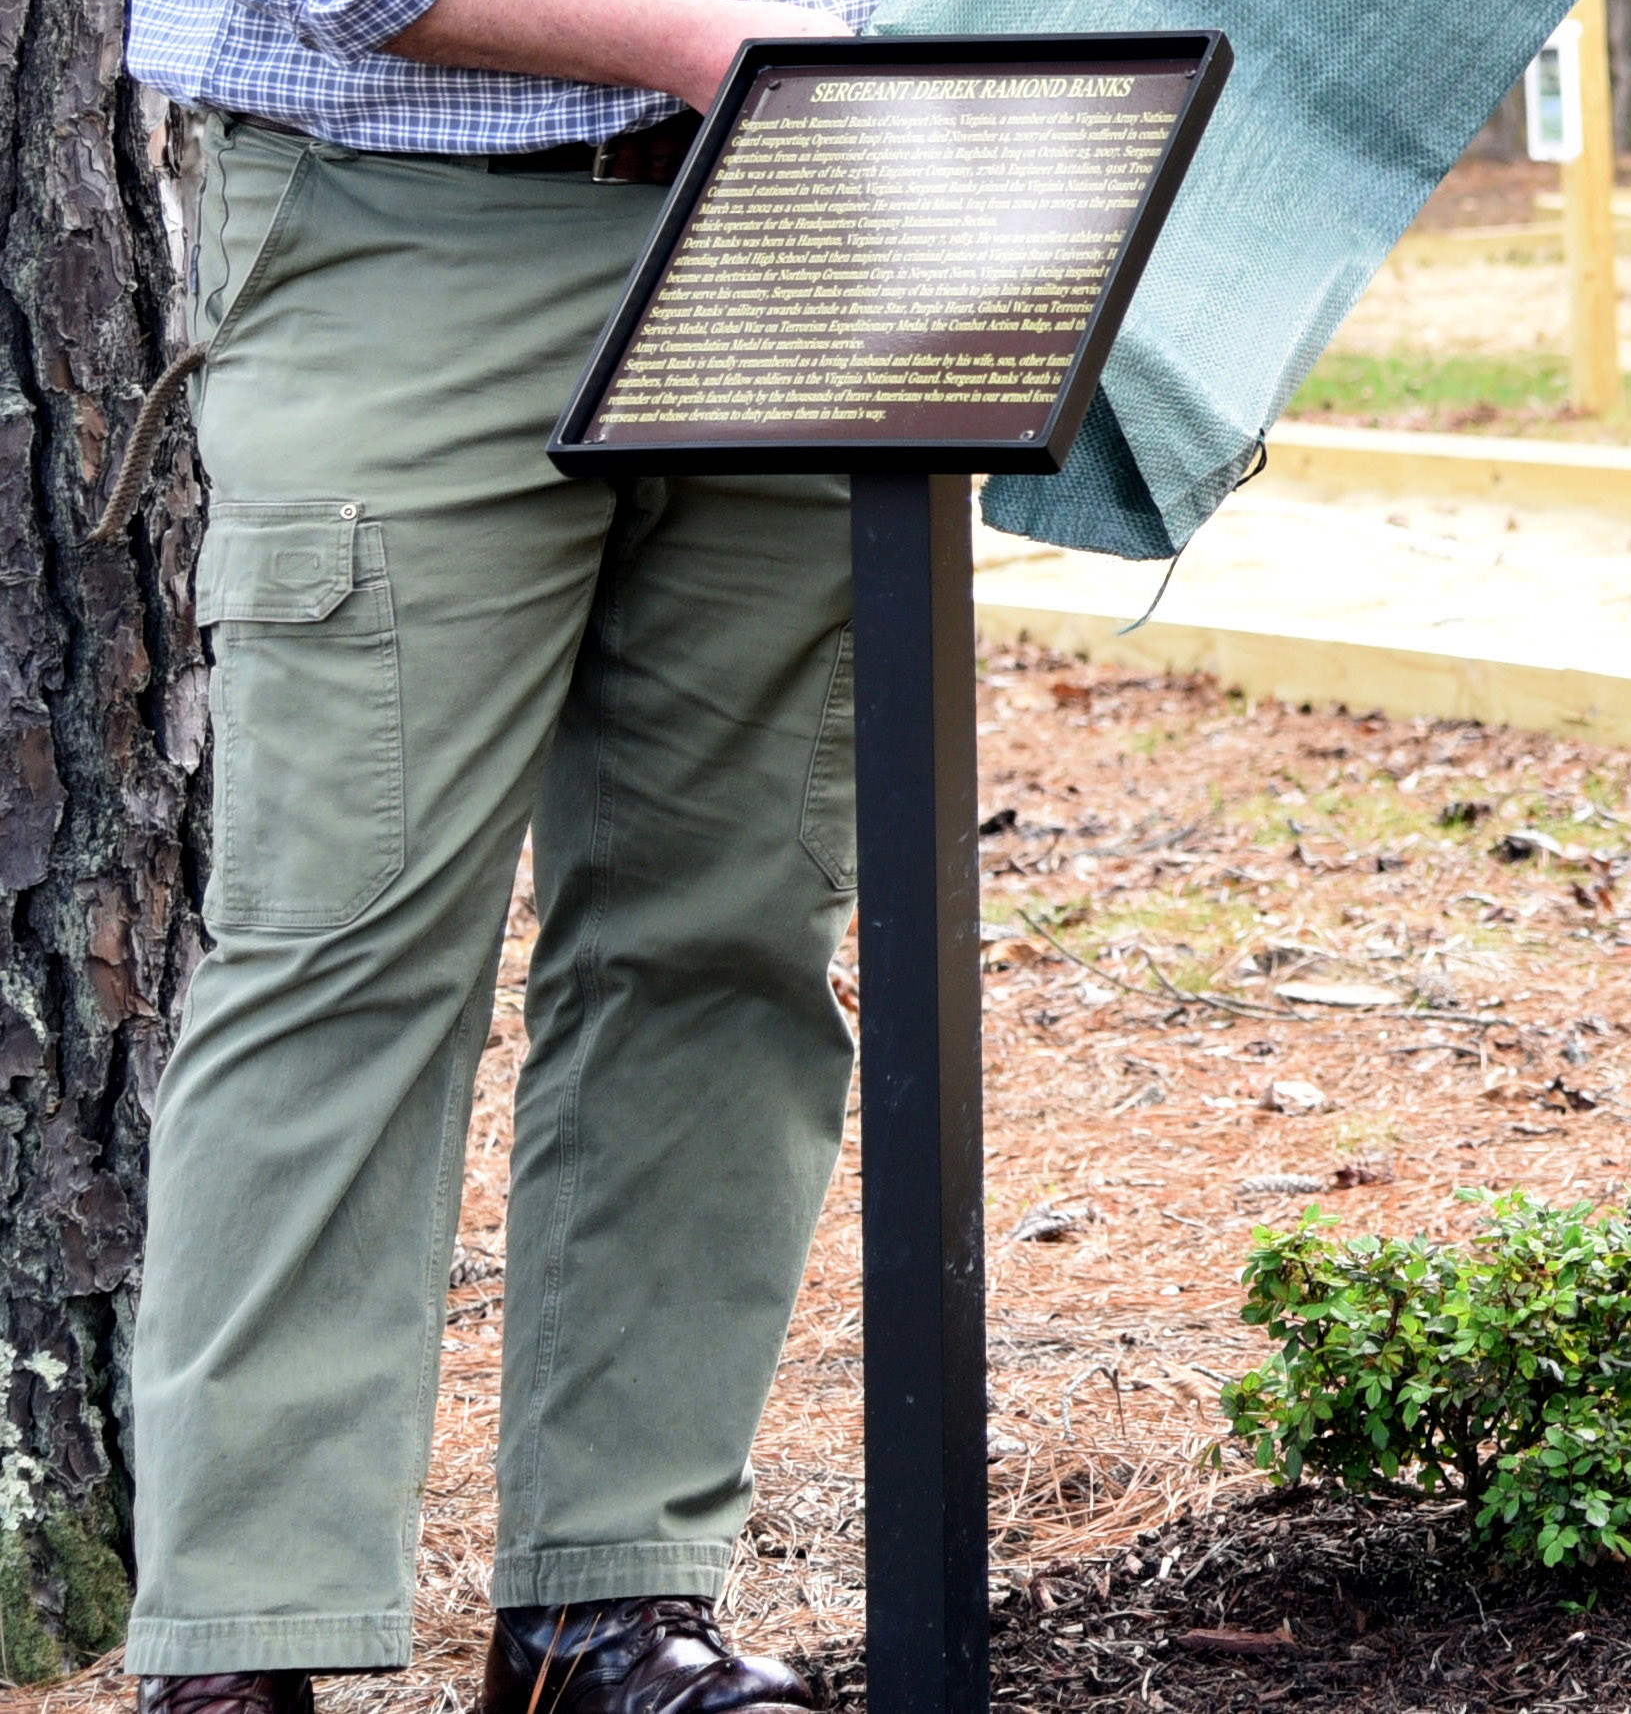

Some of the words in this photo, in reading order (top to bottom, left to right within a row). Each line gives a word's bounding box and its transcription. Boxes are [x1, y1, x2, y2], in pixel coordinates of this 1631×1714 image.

[810, 82, 914, 102] SERGEANT
[914, 80, 980, 99] DEREK
[981, 79, 1067, 98] RAMOND
[1068, 77, 1134, 97] BANKS
